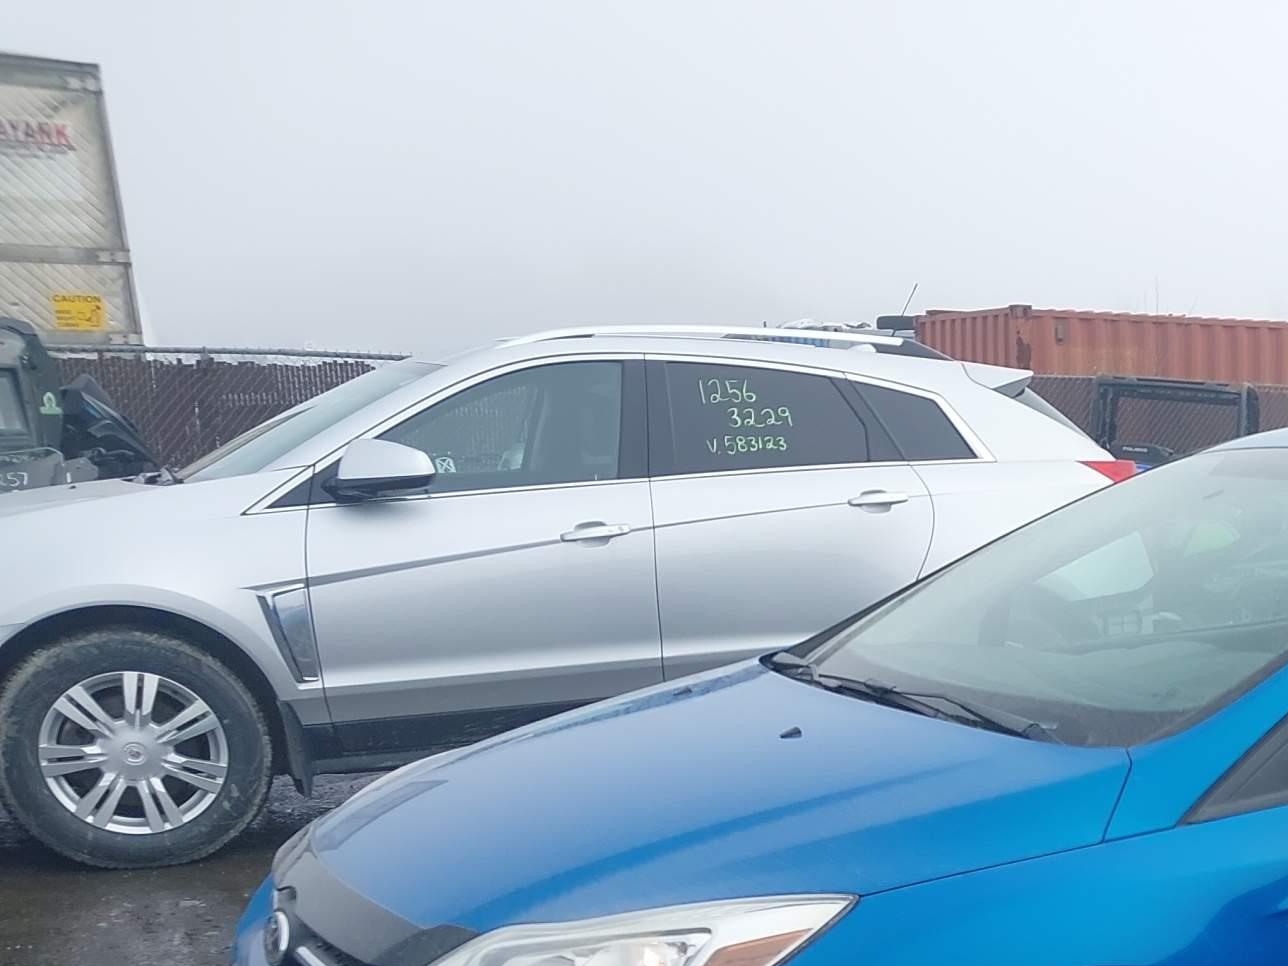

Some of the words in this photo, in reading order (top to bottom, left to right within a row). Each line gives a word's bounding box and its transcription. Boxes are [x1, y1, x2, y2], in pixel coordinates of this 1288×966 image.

[52, 294, 101, 303] CAUTION
[698, 379, 756, 404] 1256
[727, 406, 793, 428] 3229
